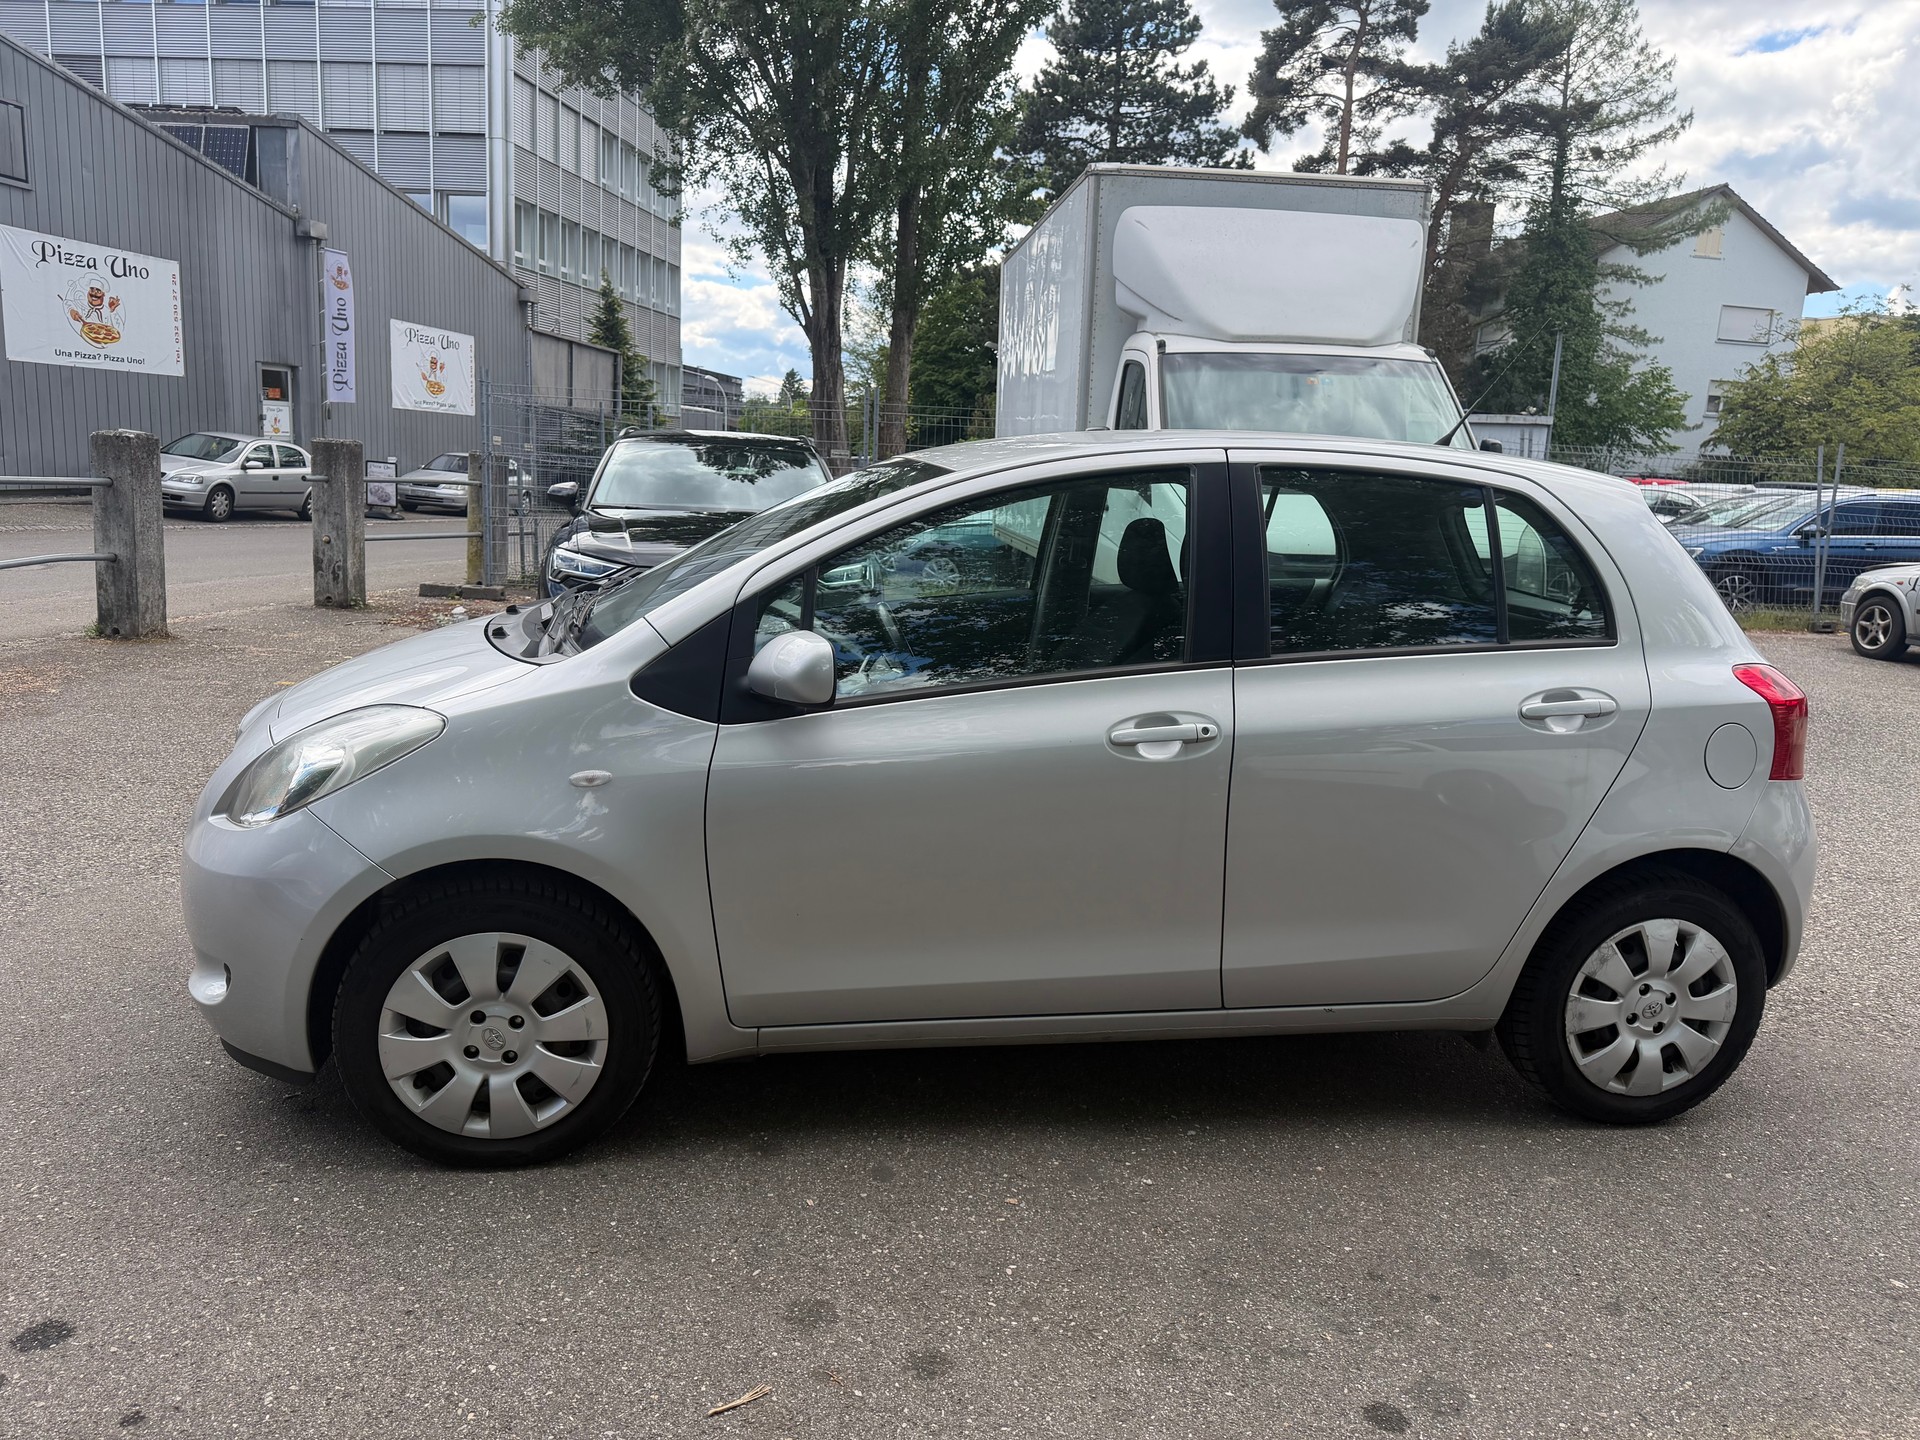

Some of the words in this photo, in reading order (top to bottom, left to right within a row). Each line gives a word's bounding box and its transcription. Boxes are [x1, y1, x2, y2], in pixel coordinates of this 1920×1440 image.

[31, 240, 98, 270] Pizza
[104, 255, 149, 280] Uno
[172, 289, 178, 301] 27
[331, 297, 350, 336] Uno
[404, 327, 435, 347] Pizza
[438, 334, 460, 350] Uno
[54, 348, 72, 359] Una
[74, 350, 102, 361] Pizza?
[103, 353, 125, 363] Pizza
[126, 356, 145, 365] Uno!
[332, 342, 353, 392] Pizza
